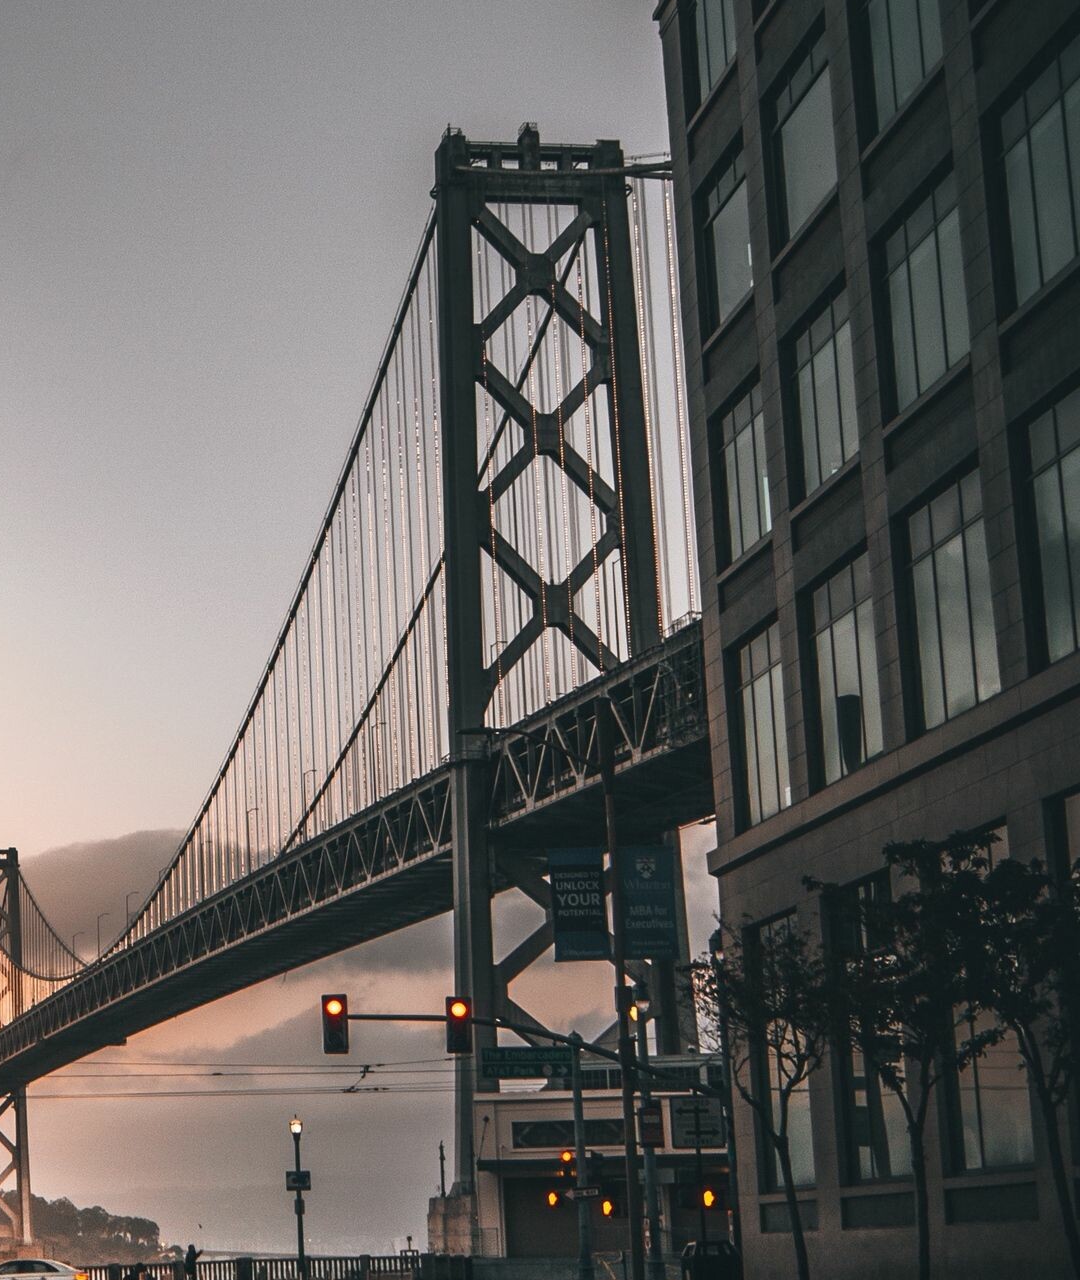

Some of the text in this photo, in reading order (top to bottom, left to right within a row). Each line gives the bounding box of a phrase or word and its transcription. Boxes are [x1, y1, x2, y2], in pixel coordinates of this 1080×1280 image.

[555, 881, 600, 891] UNLOCK
[624, 880, 672, 889] Wharton
[557, 893, 601, 907] YOUR
[629, 905, 667, 916] MBA for
[625, 918, 674, 929] Executives
[485, 1050, 572, 1060] The Embarcadero
[513, 1066, 536, 1075] Park
